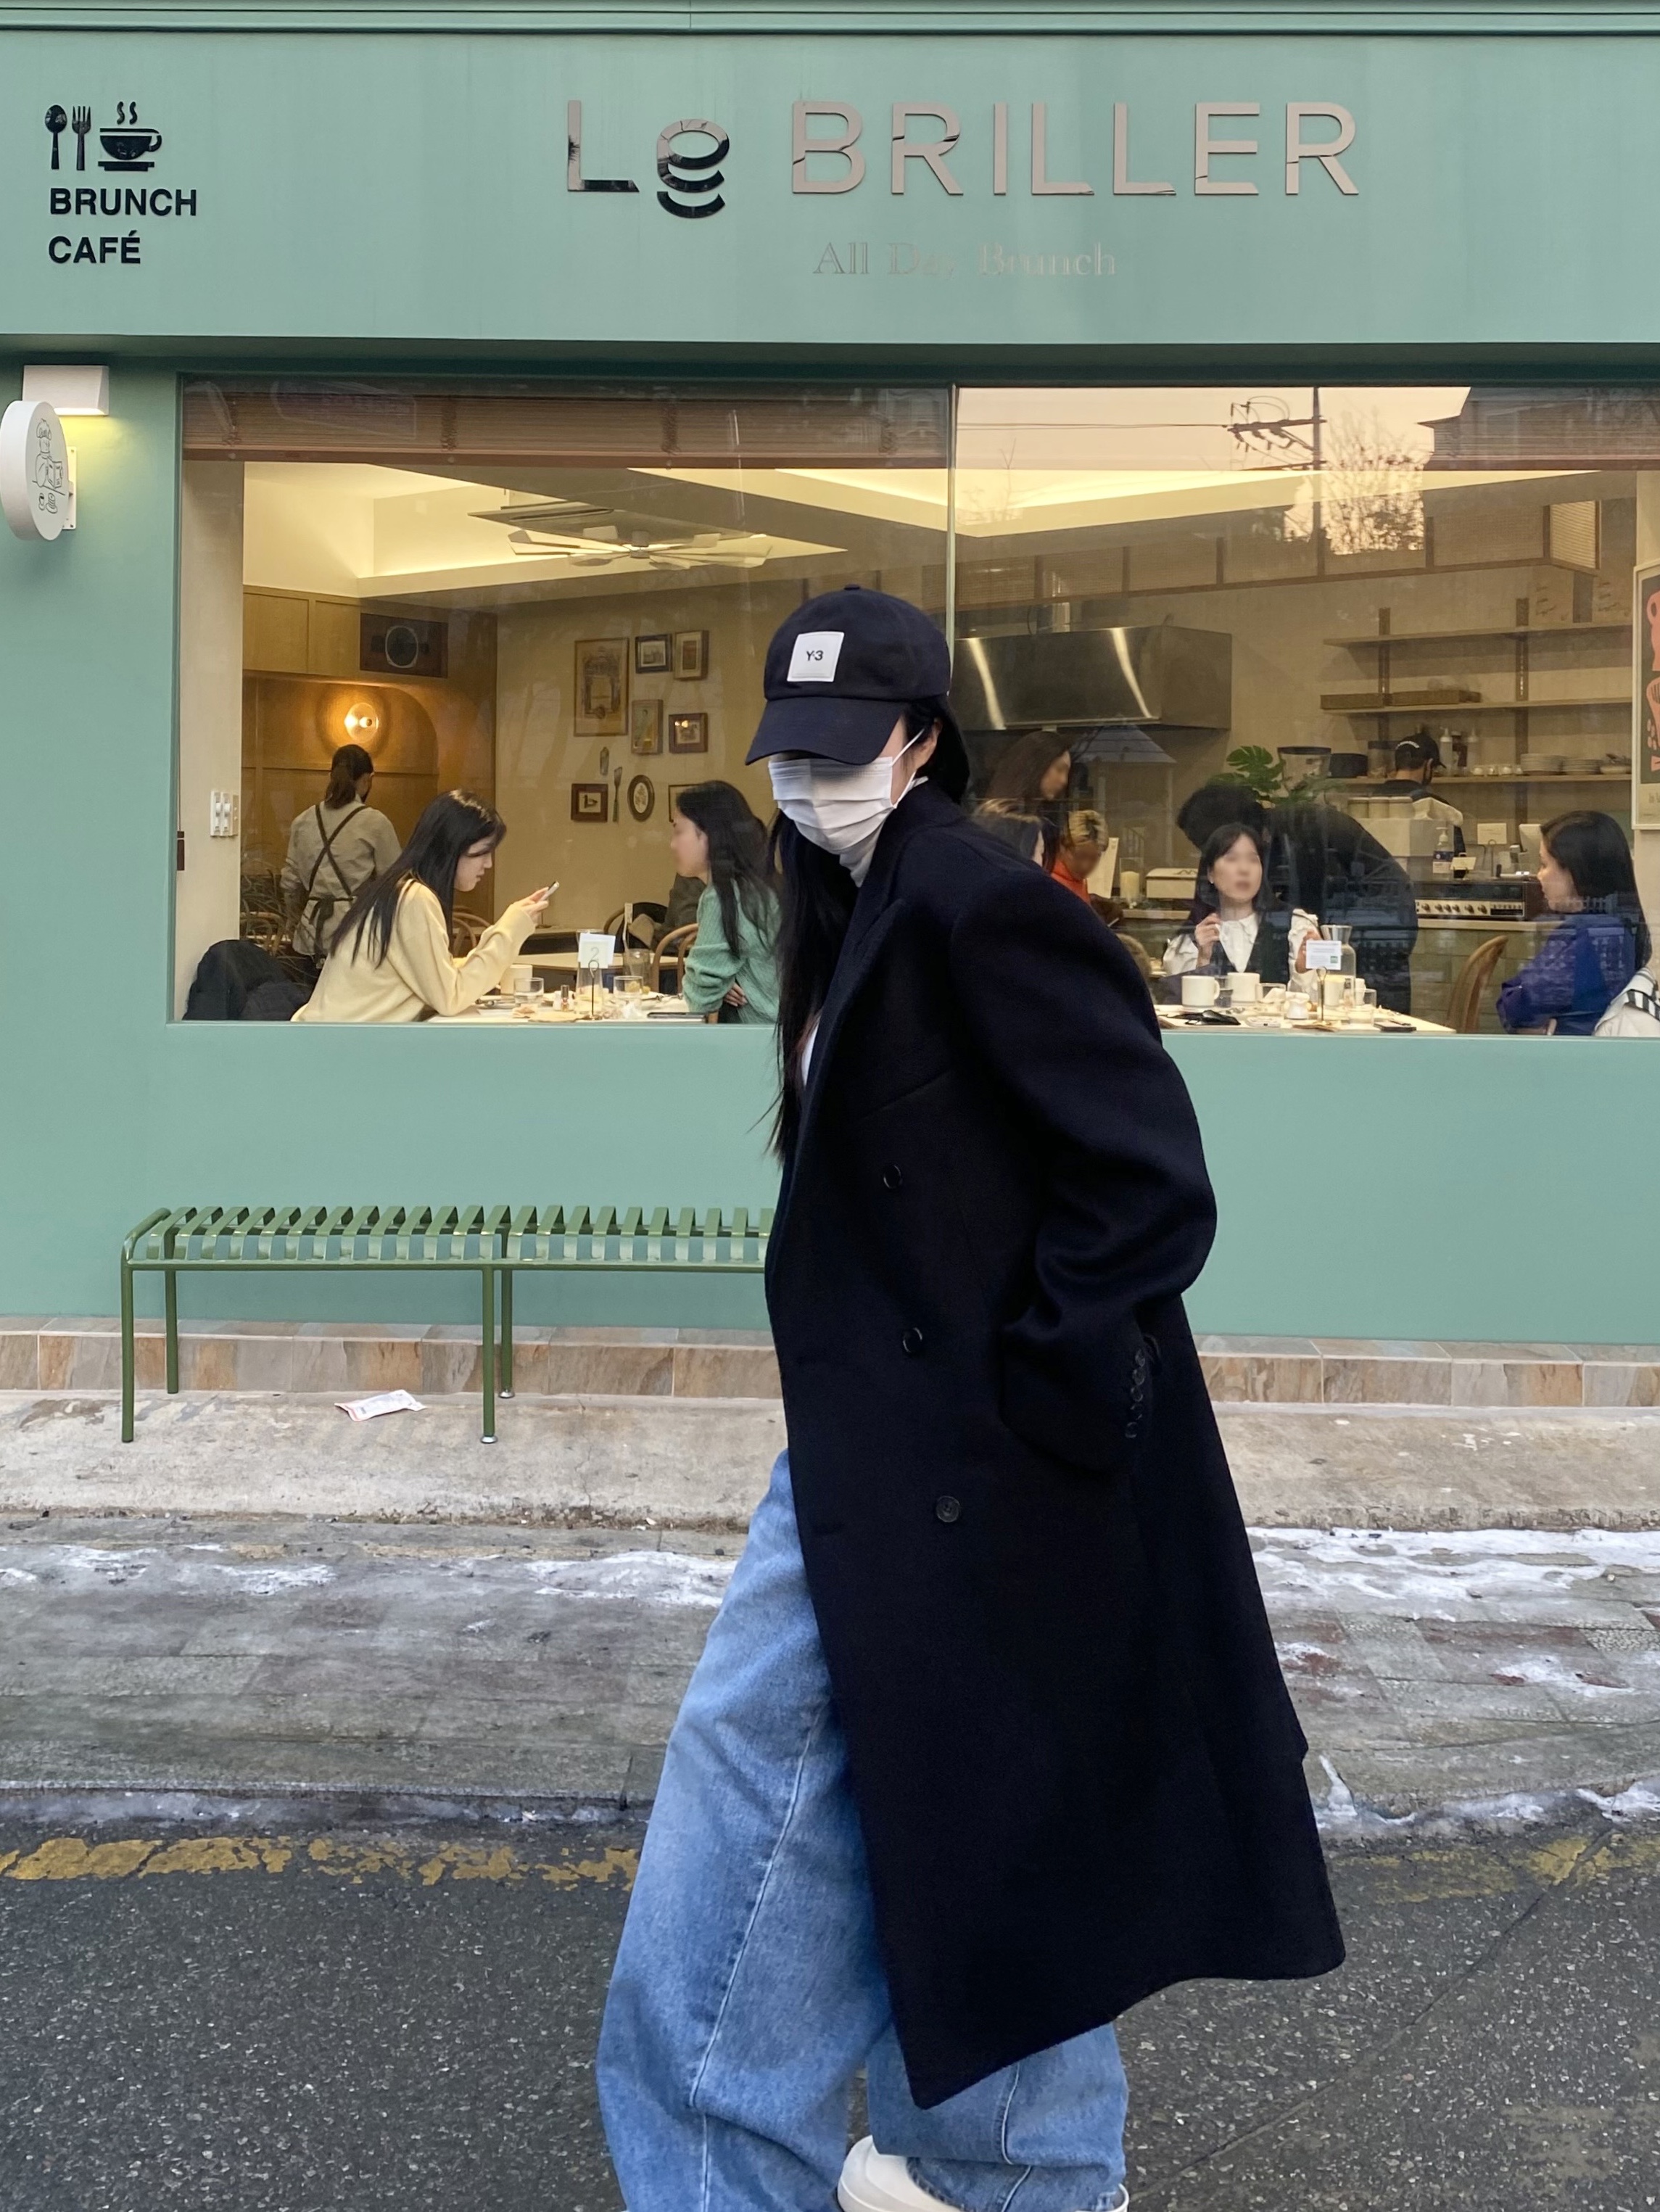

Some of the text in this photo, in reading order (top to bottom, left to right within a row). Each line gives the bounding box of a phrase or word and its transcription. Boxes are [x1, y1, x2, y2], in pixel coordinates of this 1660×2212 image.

[791, 101, 1360, 197] BRILLER
[49, 187, 198, 217] BRUNCH
[48, 230, 141, 265] CAFÉ
[812, 242, 870, 275] All
[977, 242, 1118, 276] Brunch
